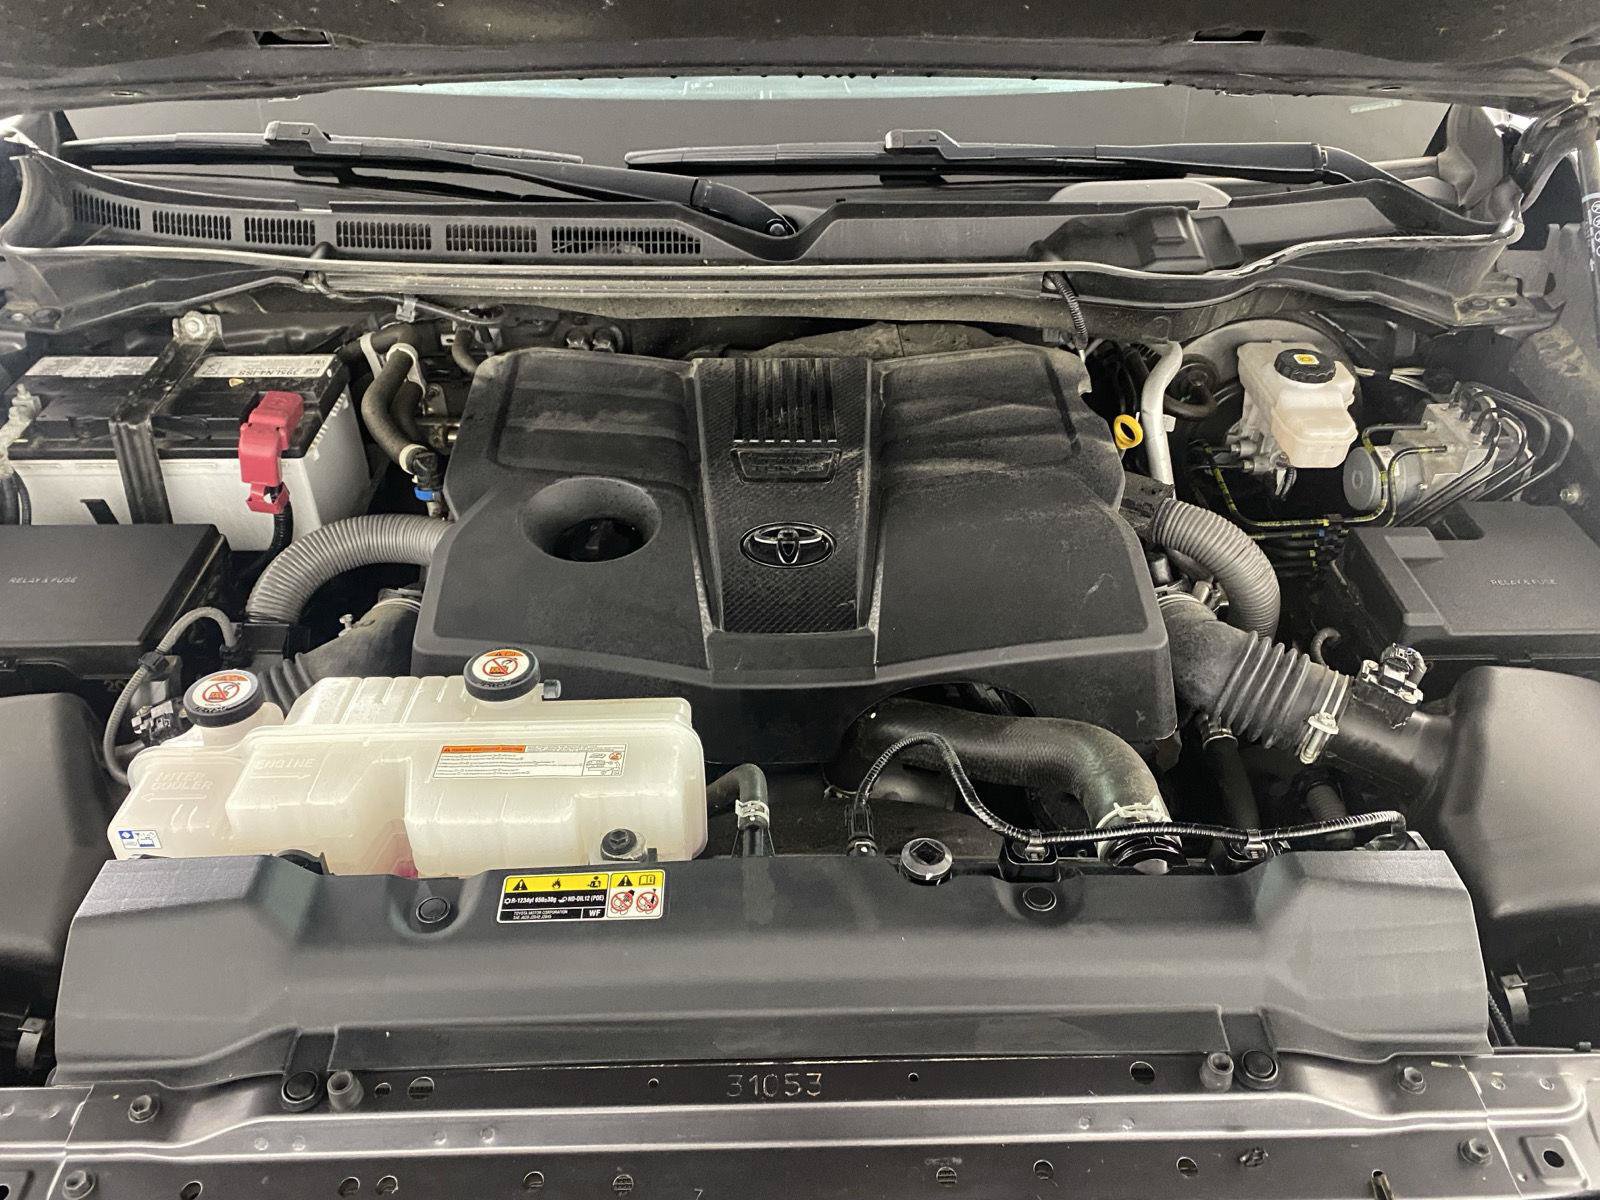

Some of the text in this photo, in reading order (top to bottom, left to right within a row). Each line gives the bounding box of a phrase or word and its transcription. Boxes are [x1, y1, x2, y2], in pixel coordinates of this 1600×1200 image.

[254, 758, 316, 770] ENGINE
[589, 909, 602, 917] WF
[726, 1072, 822, 1097] 31053
